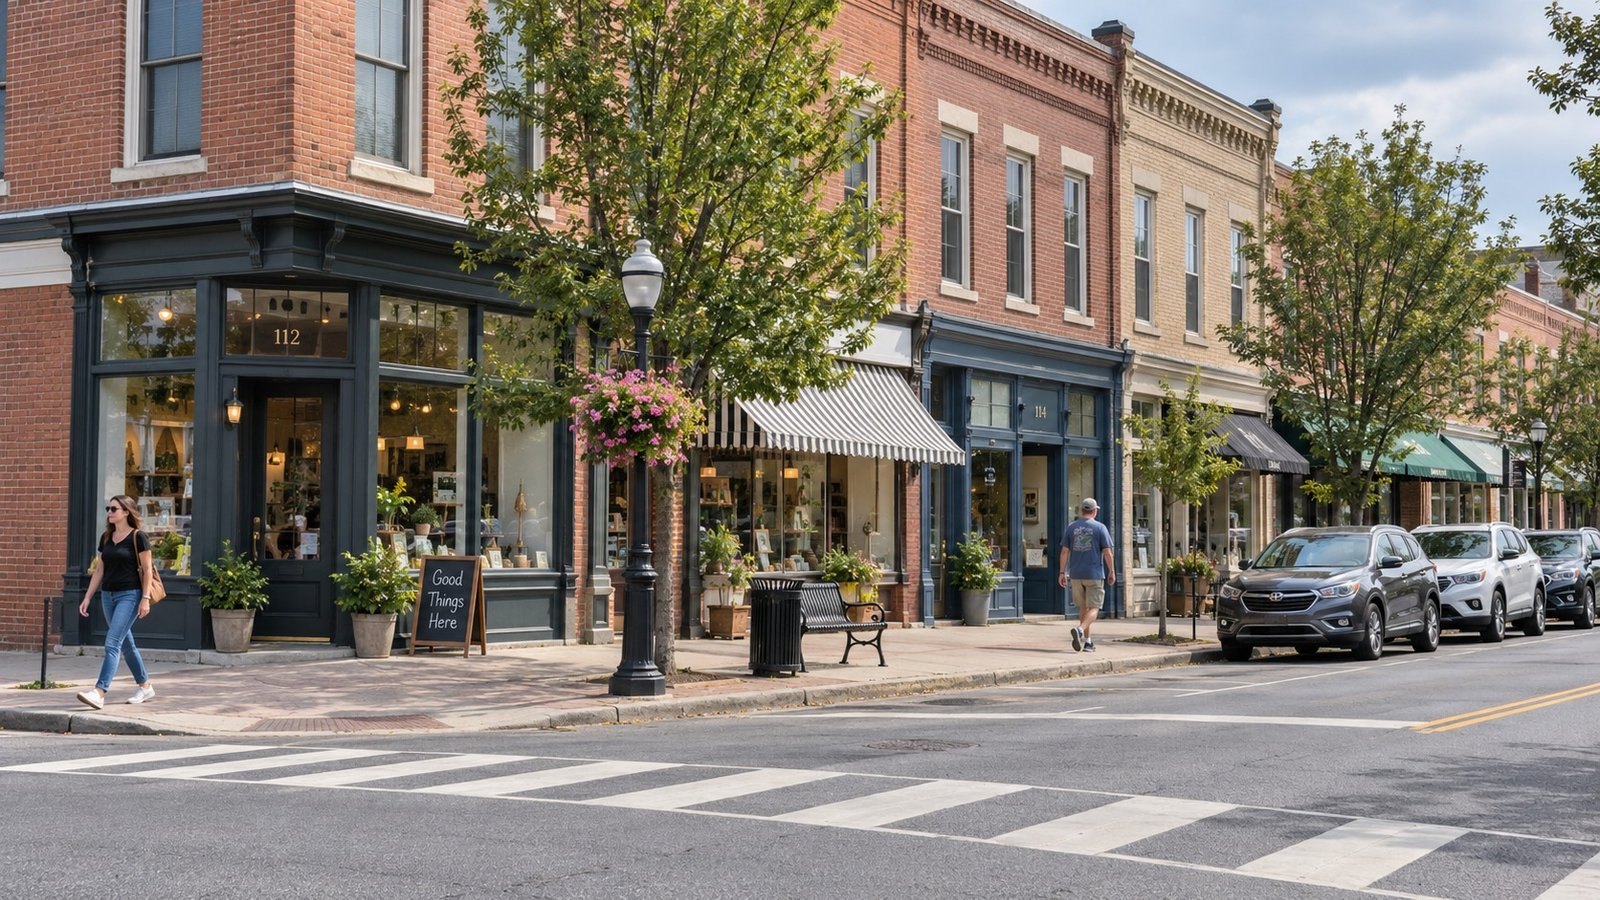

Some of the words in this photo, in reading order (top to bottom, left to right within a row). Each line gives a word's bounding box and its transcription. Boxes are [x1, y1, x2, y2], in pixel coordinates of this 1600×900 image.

[274, 329, 300, 345] 112
[1035, 405, 1047, 418] 114
[432, 568, 463, 586] Good
[428, 591, 464, 613] Things
[428, 612, 457, 629] Here
